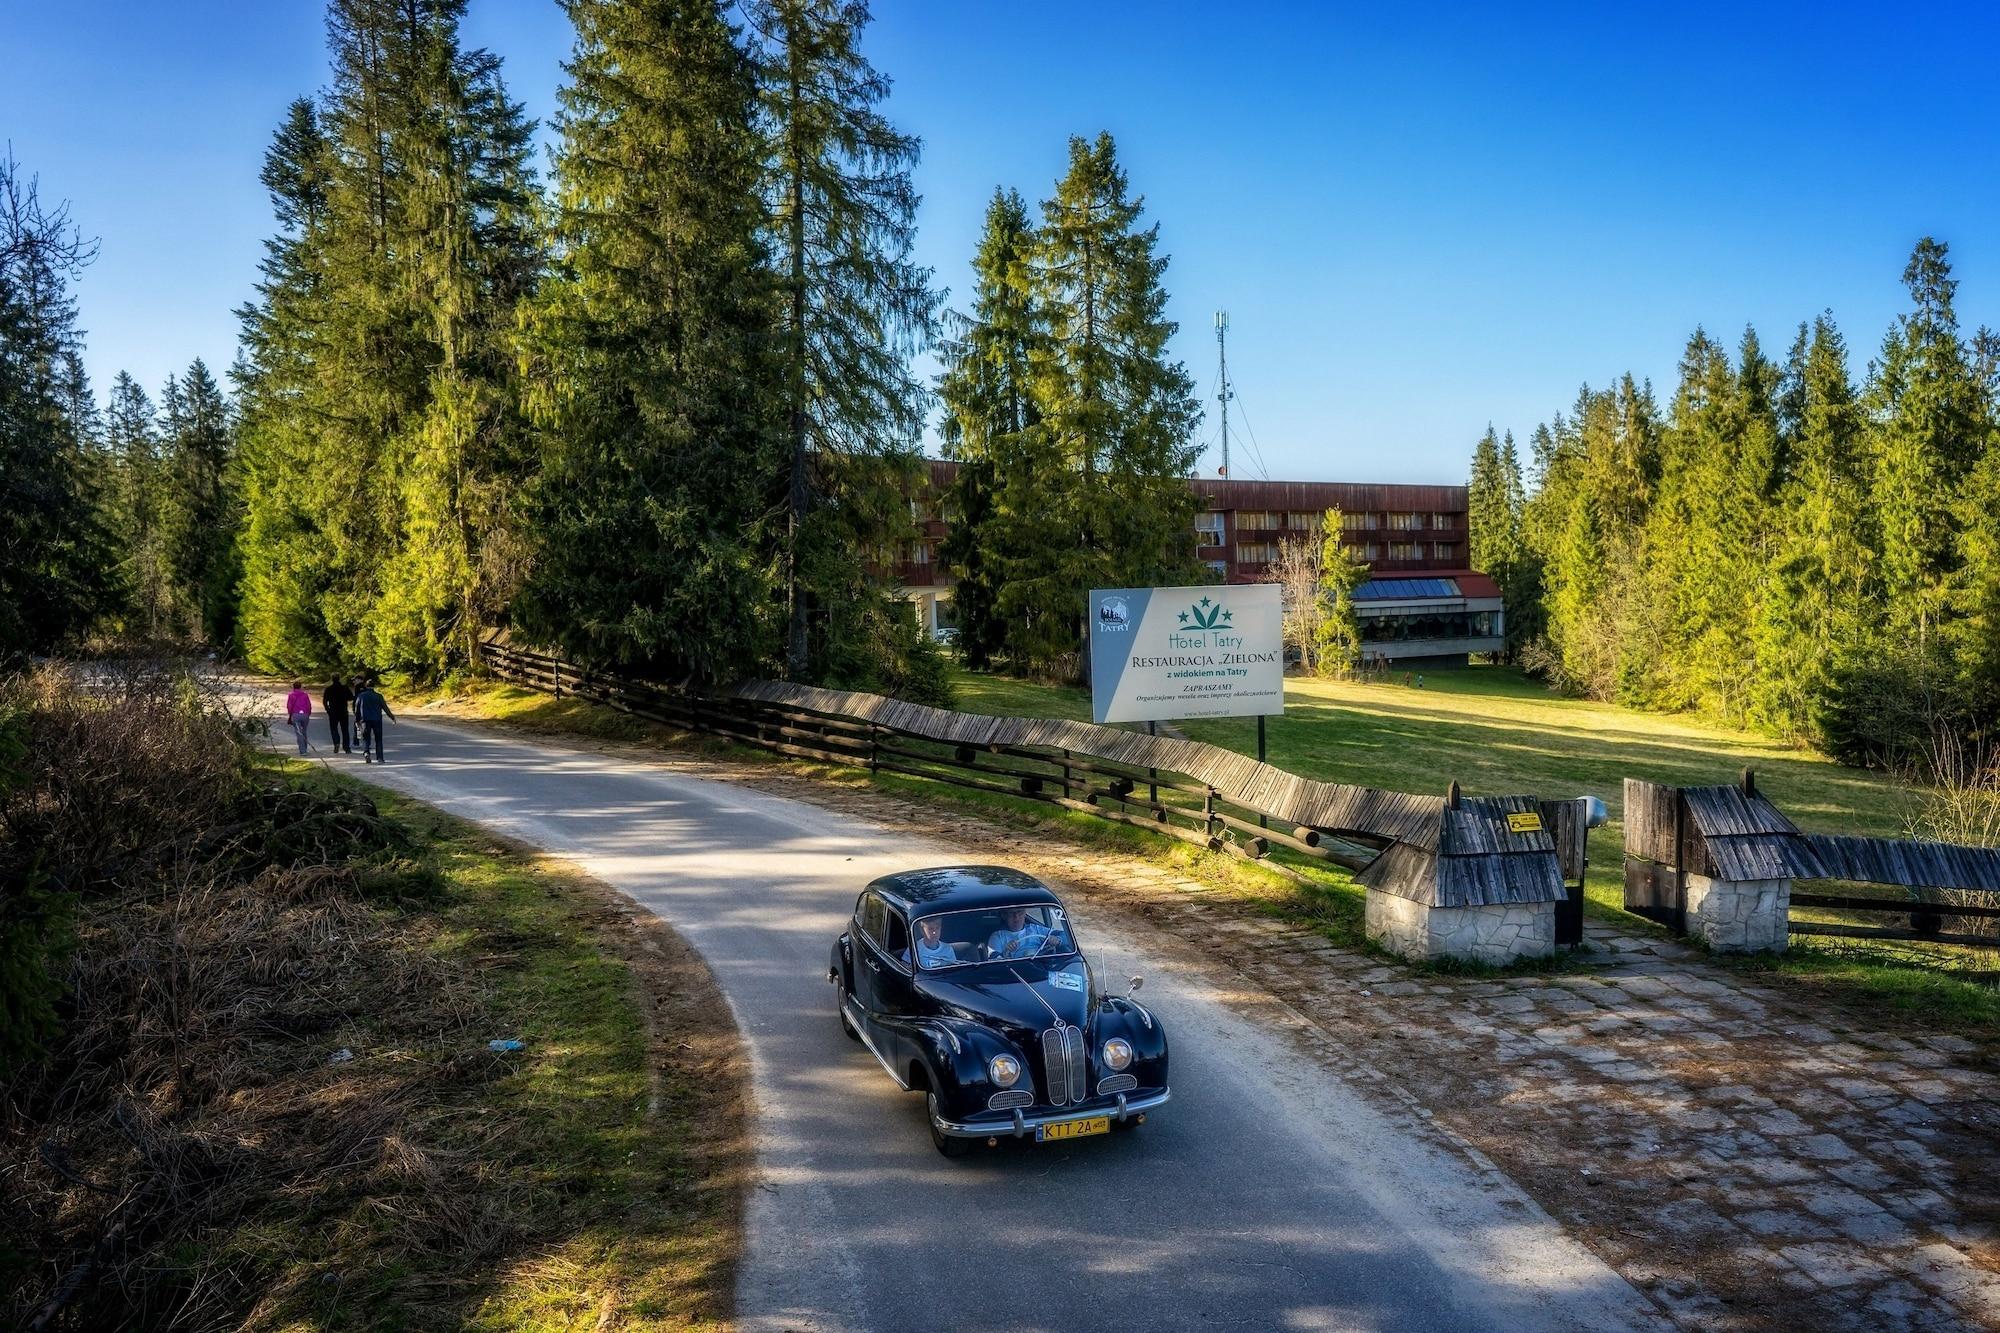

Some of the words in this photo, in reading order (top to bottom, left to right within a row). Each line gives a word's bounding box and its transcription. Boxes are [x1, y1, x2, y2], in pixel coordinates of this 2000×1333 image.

[1098, 620, 1130, 632] TATRY
[1169, 633, 1207, 649] Hotel
[1212, 631, 1243, 650] Tatry
[1173, 669, 1214, 678] widokiem
[1226, 668, 1248, 677] Tatry
[1183, 683, 1233, 692] ZAPRASZAMY
[1045, 1122, 1072, 1138] KTT
[1077, 1120, 1091, 1134] 2A
